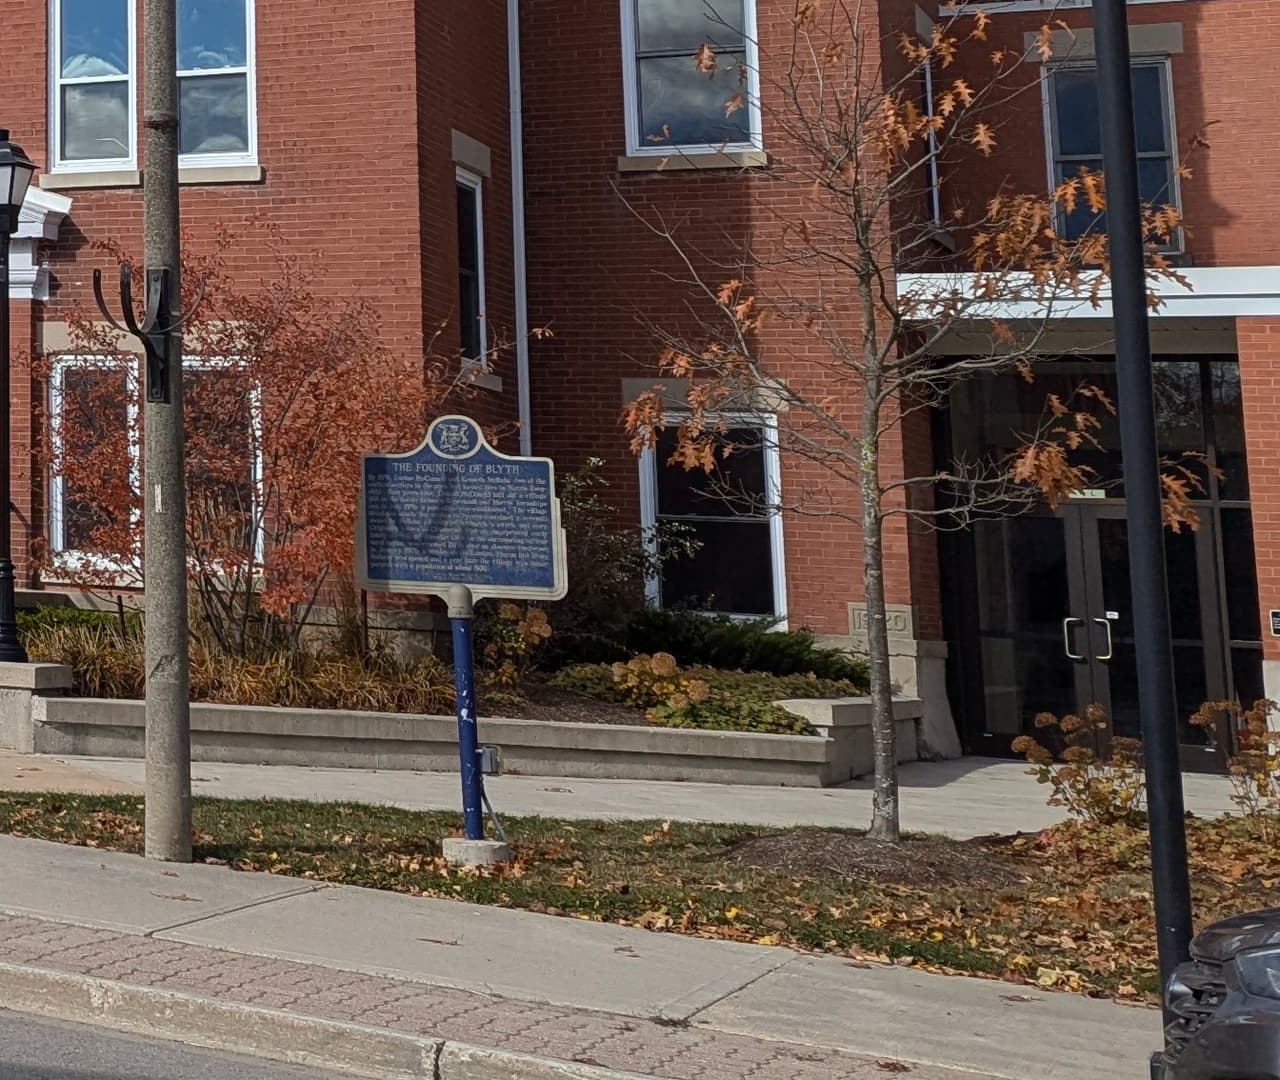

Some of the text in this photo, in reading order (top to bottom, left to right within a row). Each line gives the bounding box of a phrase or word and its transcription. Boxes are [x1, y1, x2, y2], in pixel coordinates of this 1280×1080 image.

[393, 463, 520, 474] THE FOUNDING OF BLYTH
